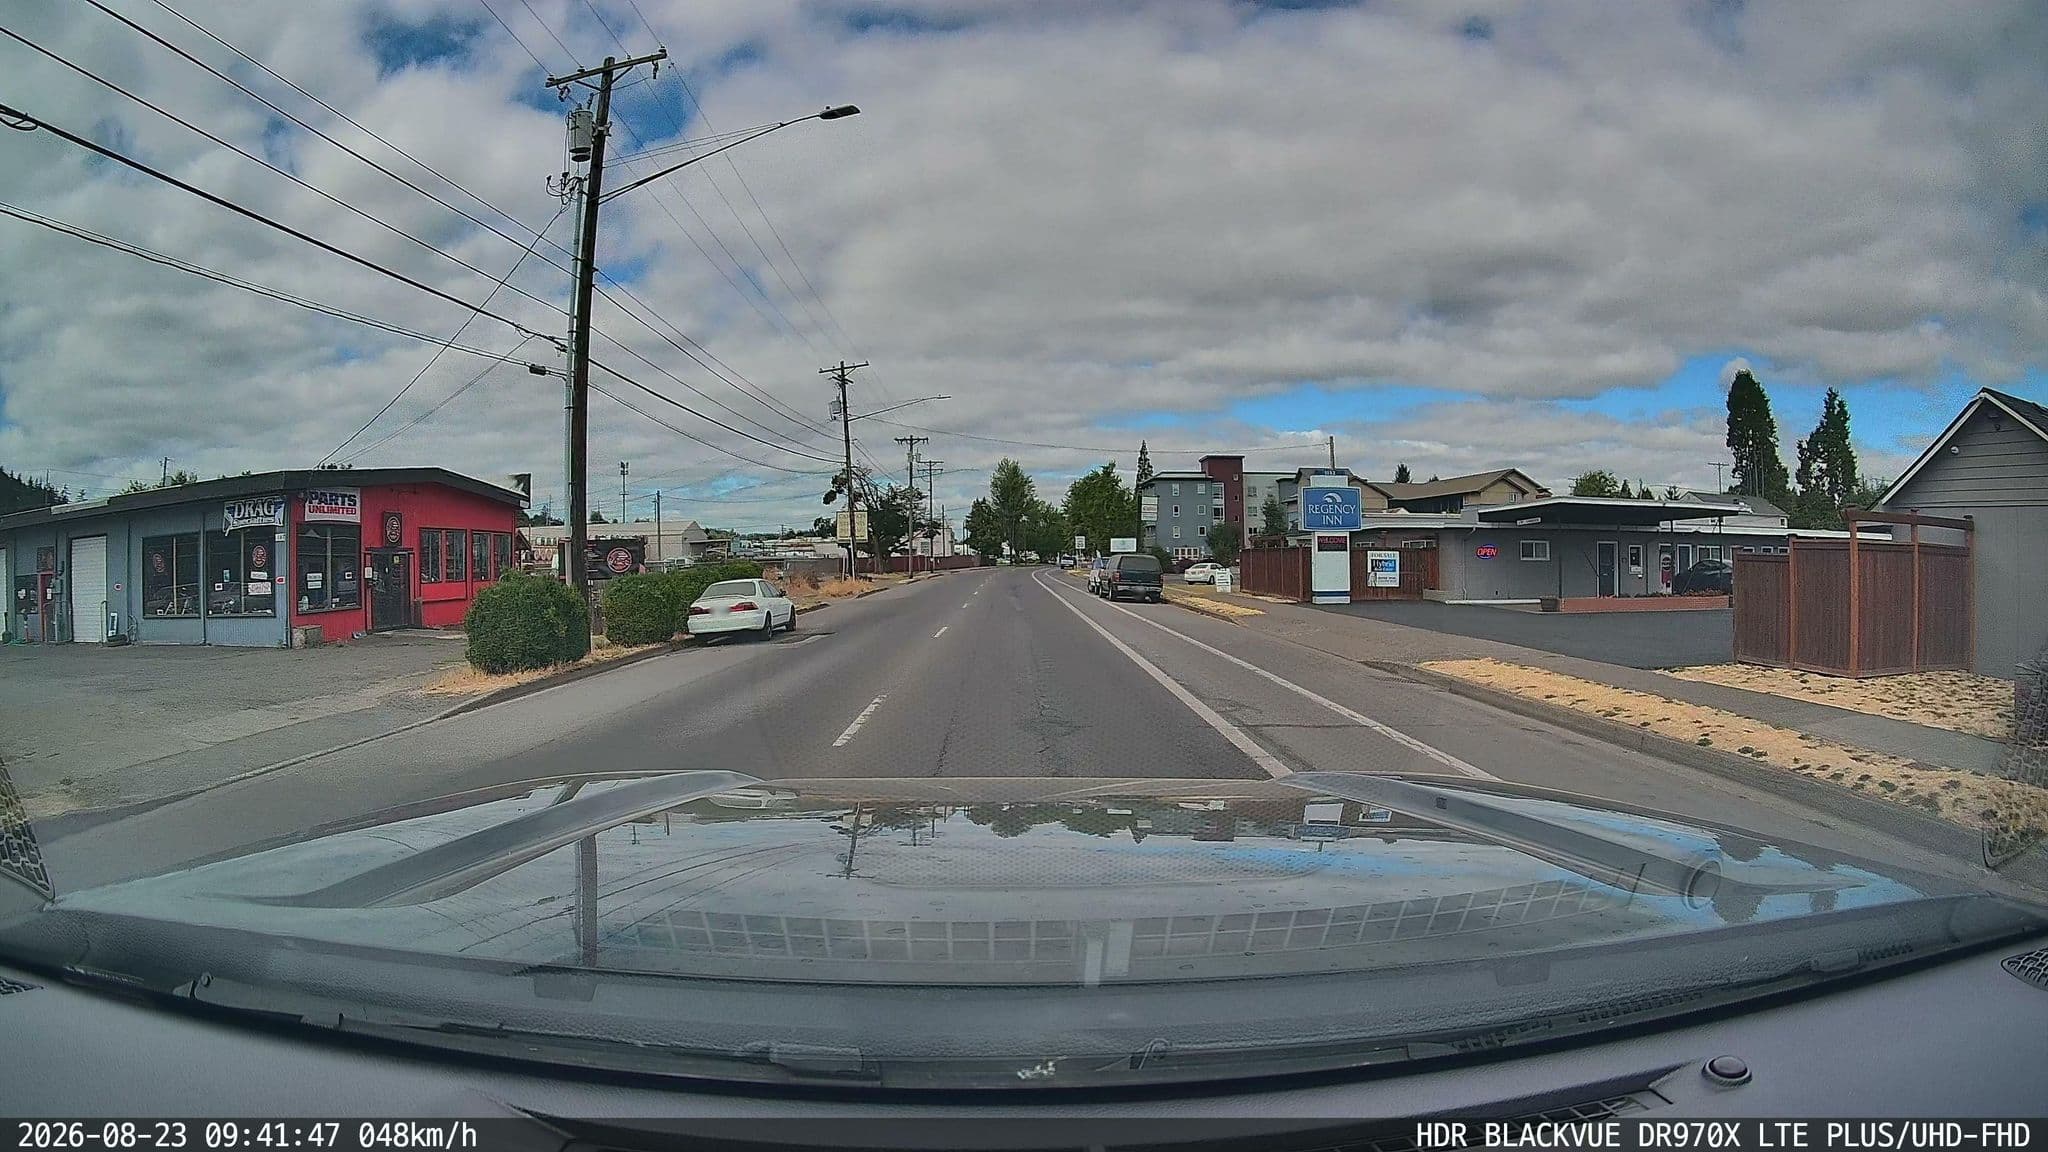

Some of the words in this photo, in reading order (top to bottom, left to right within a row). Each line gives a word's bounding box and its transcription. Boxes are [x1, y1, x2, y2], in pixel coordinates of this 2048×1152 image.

[307, 490, 357, 506] PARTS
[234, 499, 275, 519] DRAG
[309, 505, 357, 515] UNLIMITED
[1308, 504, 1357, 514] REGENCY
[1323, 515, 1343, 525] INN
[1477, 548, 1497, 556] OPEN
